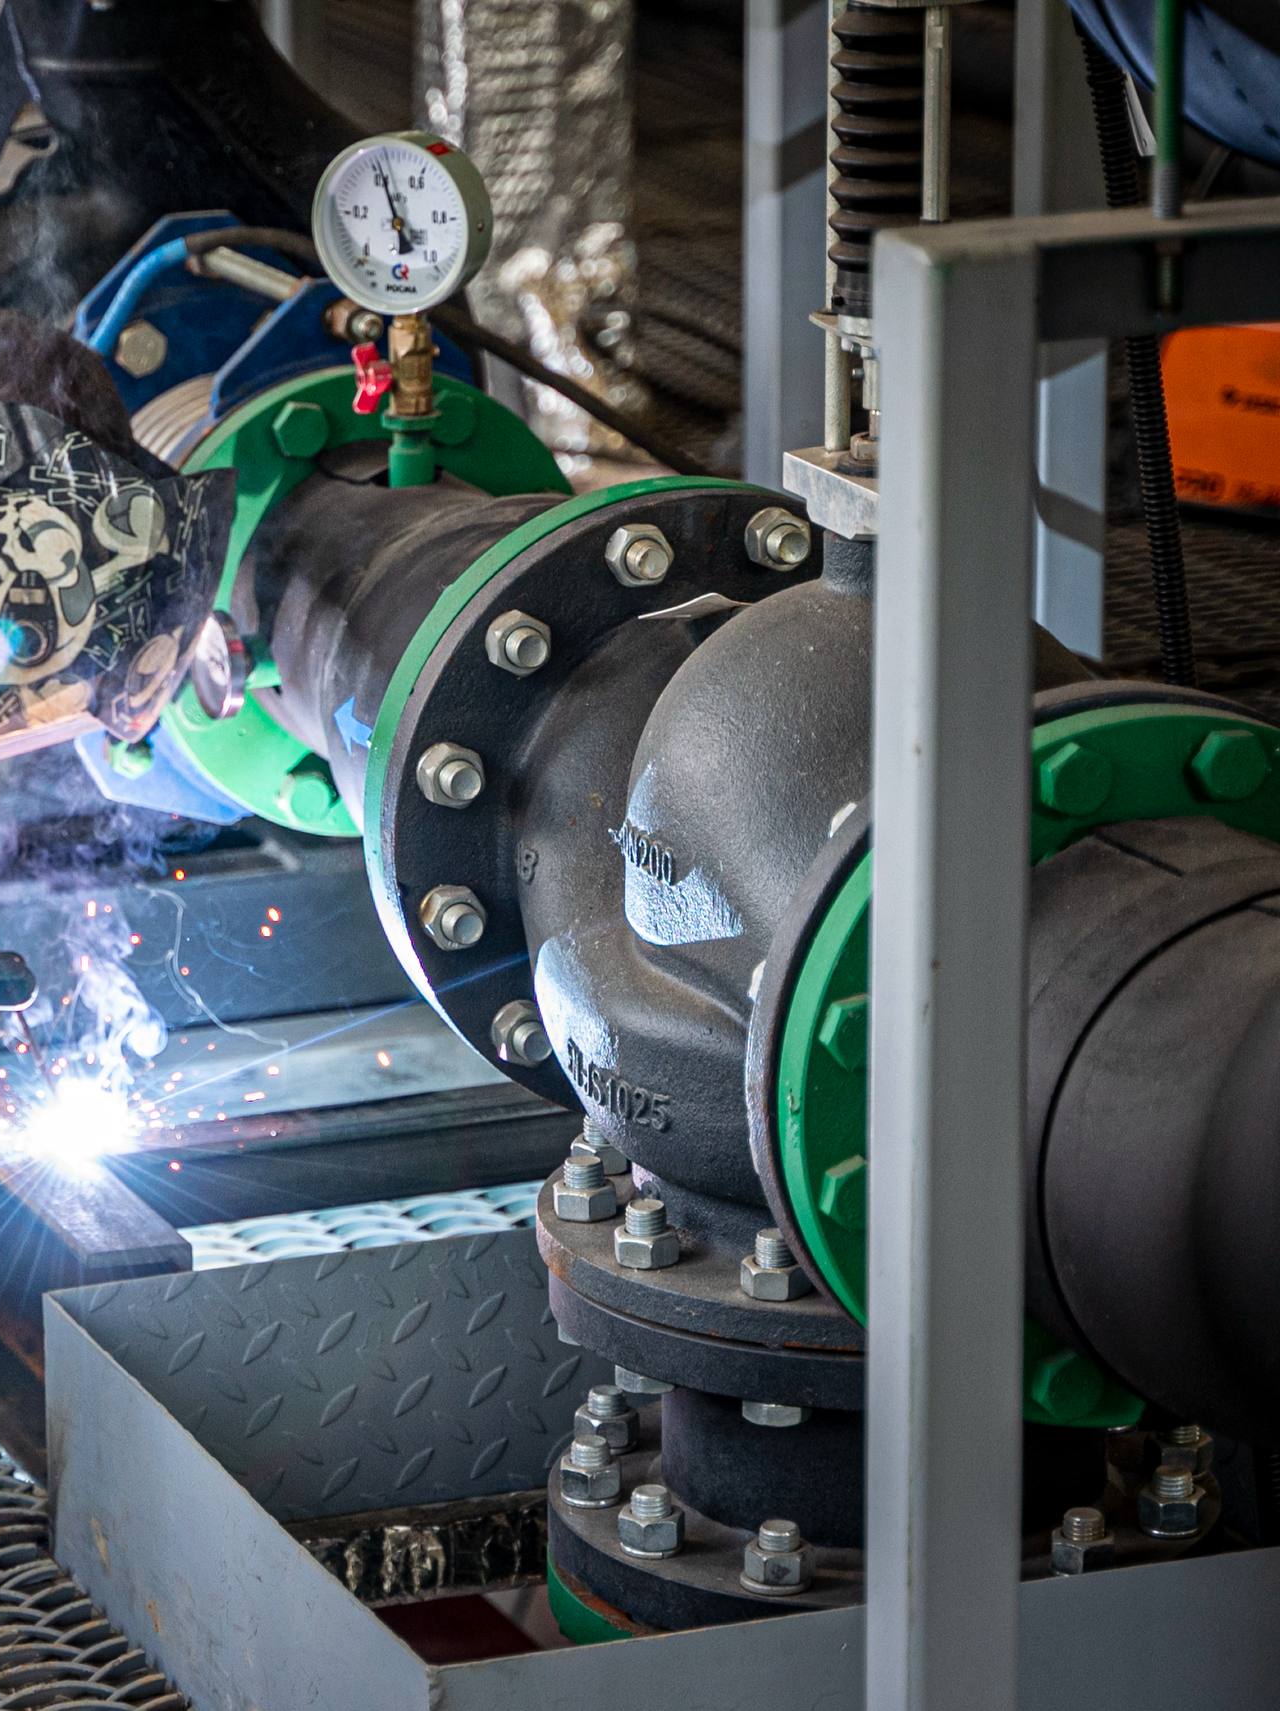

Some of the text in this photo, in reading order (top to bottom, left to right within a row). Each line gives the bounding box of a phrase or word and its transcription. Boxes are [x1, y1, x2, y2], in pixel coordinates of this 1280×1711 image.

[408, 175, 425, 191] 0,6
[352, 205, 369, 220] 0,2
[432, 210, 448, 225] 0,8
[423, 250, 438, 264] 1,0
